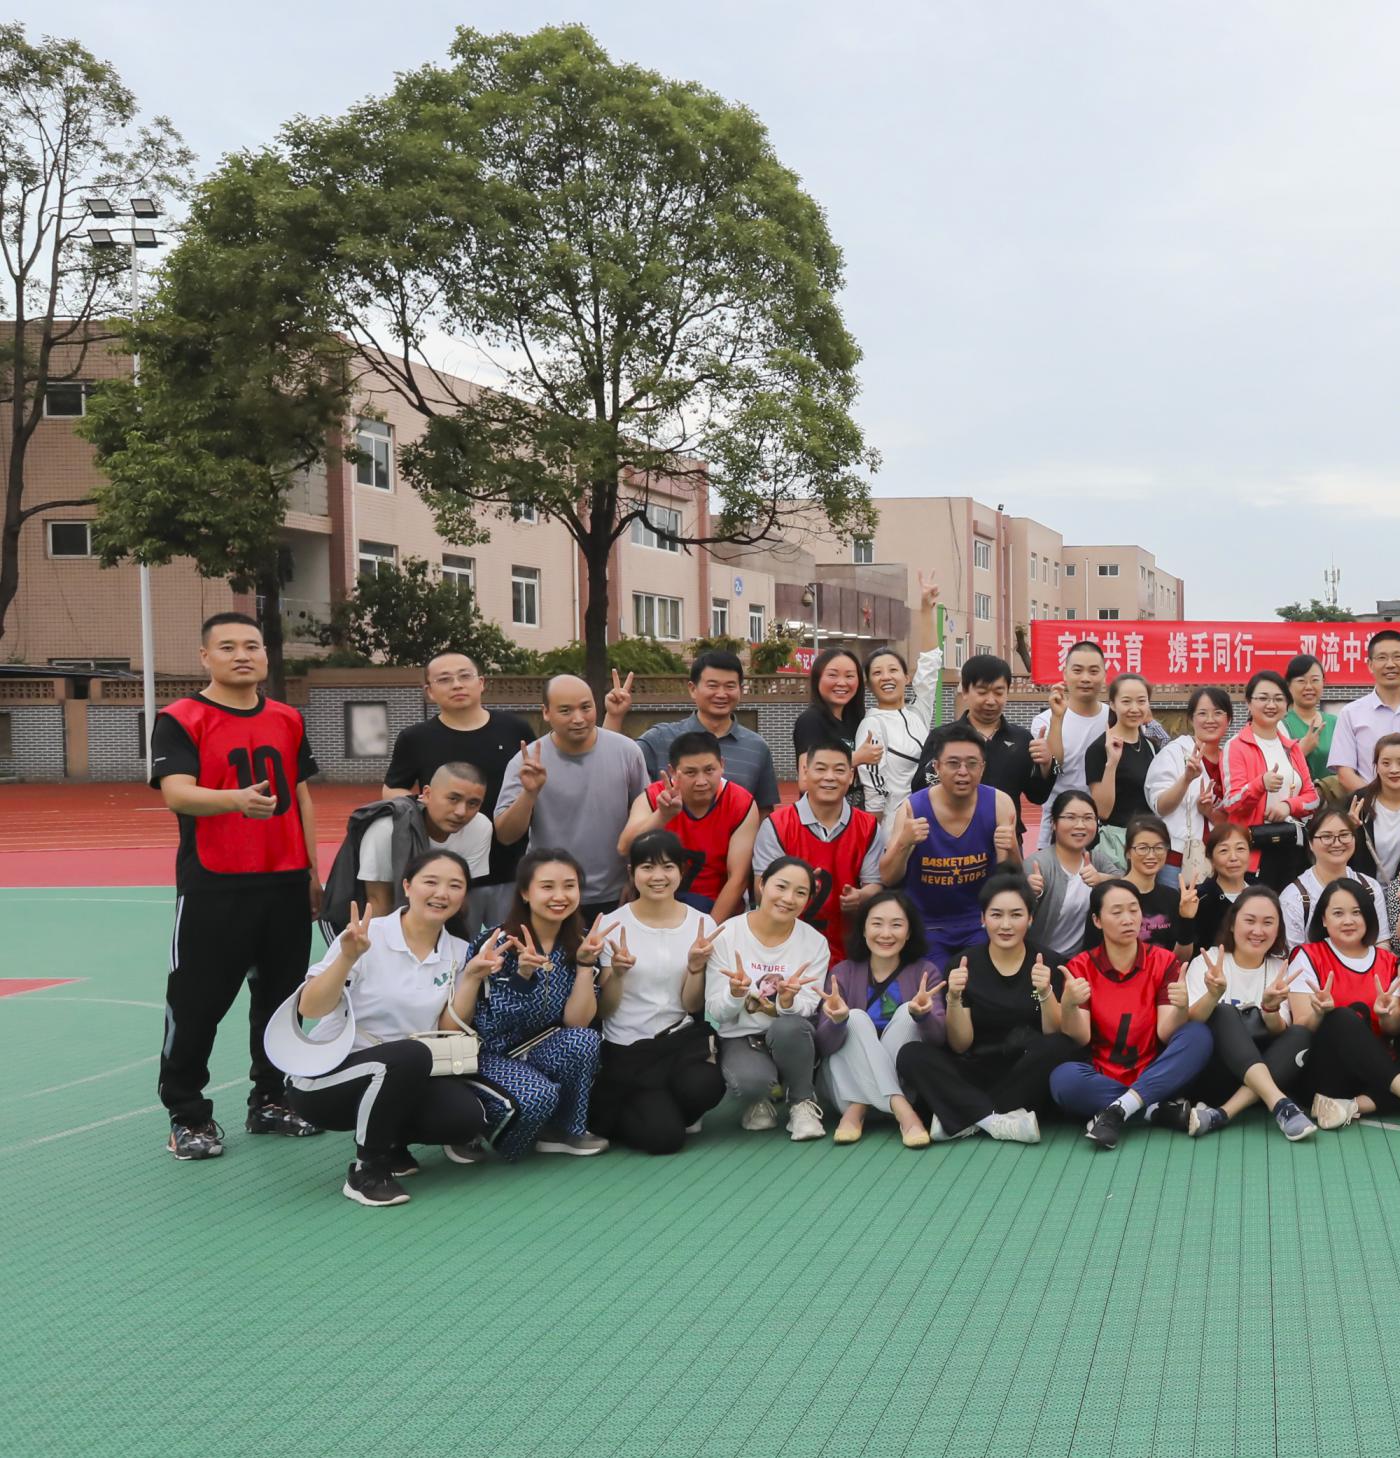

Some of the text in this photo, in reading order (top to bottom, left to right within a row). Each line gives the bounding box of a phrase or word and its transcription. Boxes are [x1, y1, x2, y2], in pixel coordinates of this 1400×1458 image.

[1057, 631, 1145, 674] 家共育
[227, 744, 292, 817] 10
[922, 852, 988, 868] BASKETBALL
[921, 868, 987, 886] NEVER STOPS
[751, 962, 786, 973] NATURE
[1109, 1012, 1140, 1070] 4
